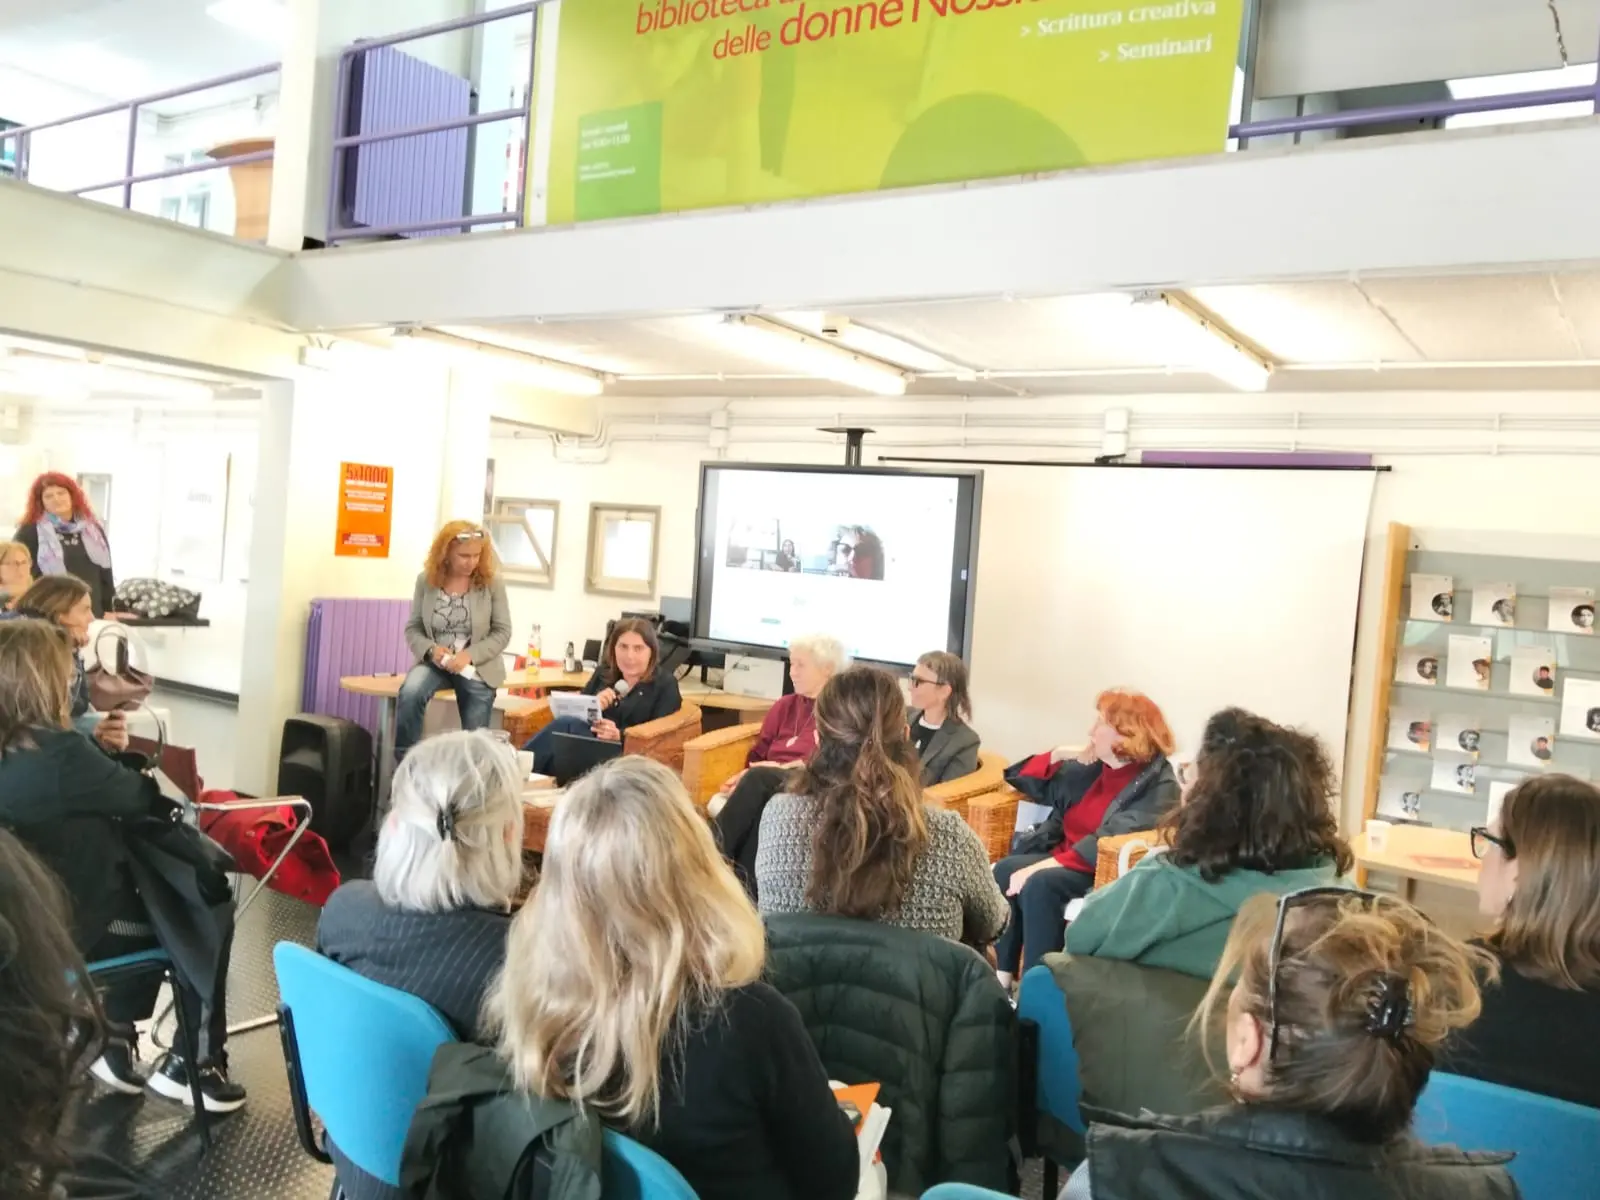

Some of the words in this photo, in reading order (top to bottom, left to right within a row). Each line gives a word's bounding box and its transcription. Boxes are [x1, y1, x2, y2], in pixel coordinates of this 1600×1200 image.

[713, 24, 771, 60] delle
[780, 2, 904, 46] donne
[1037, 9, 1122, 36] Scrittura
[1128, 0, 1216, 24] creativa
[1117, 34, 1212, 61] Seminari
